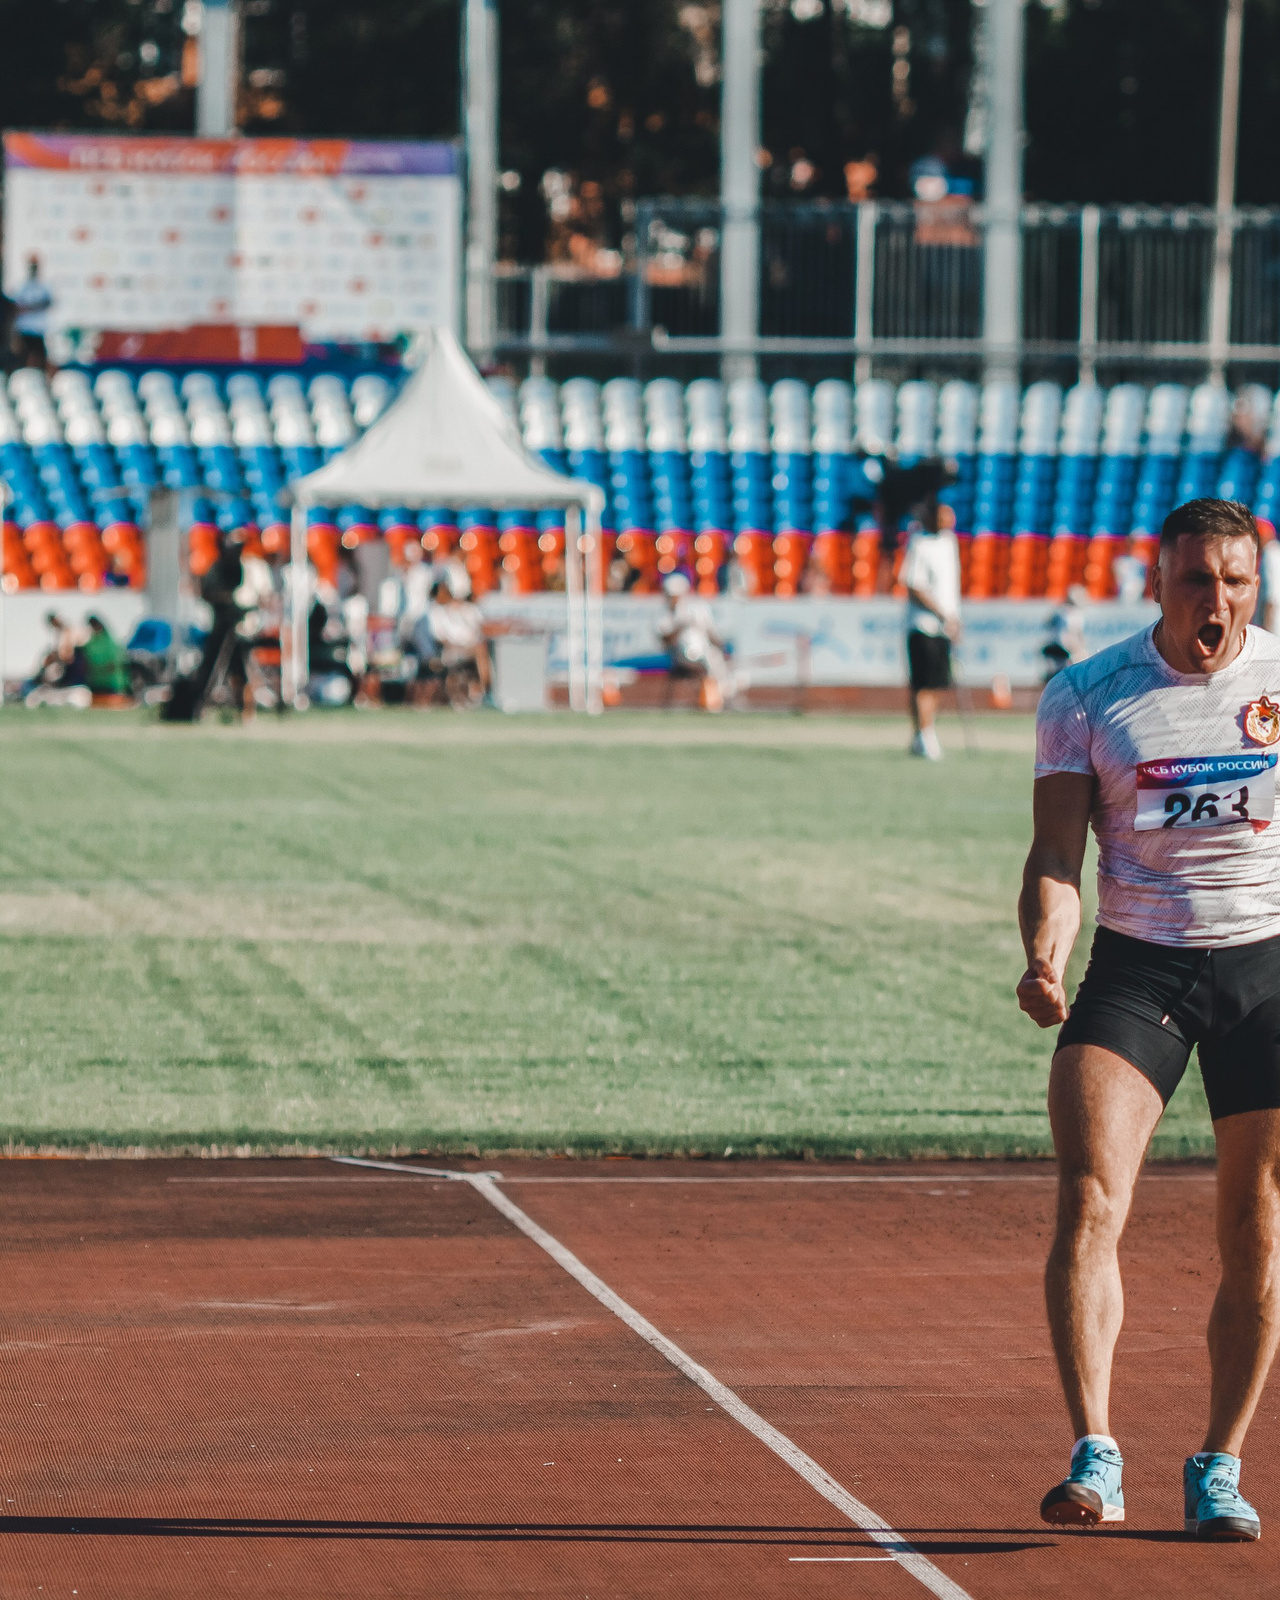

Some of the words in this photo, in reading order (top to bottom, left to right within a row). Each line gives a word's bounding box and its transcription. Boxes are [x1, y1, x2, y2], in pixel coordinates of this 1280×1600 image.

[1171, 762, 1215, 774] КУБОК
[1217, 760, 1269, 771] РОССИИ
[1163, 786, 1250, 828] 263
[1209, 1477, 1237, 1490] NIK
